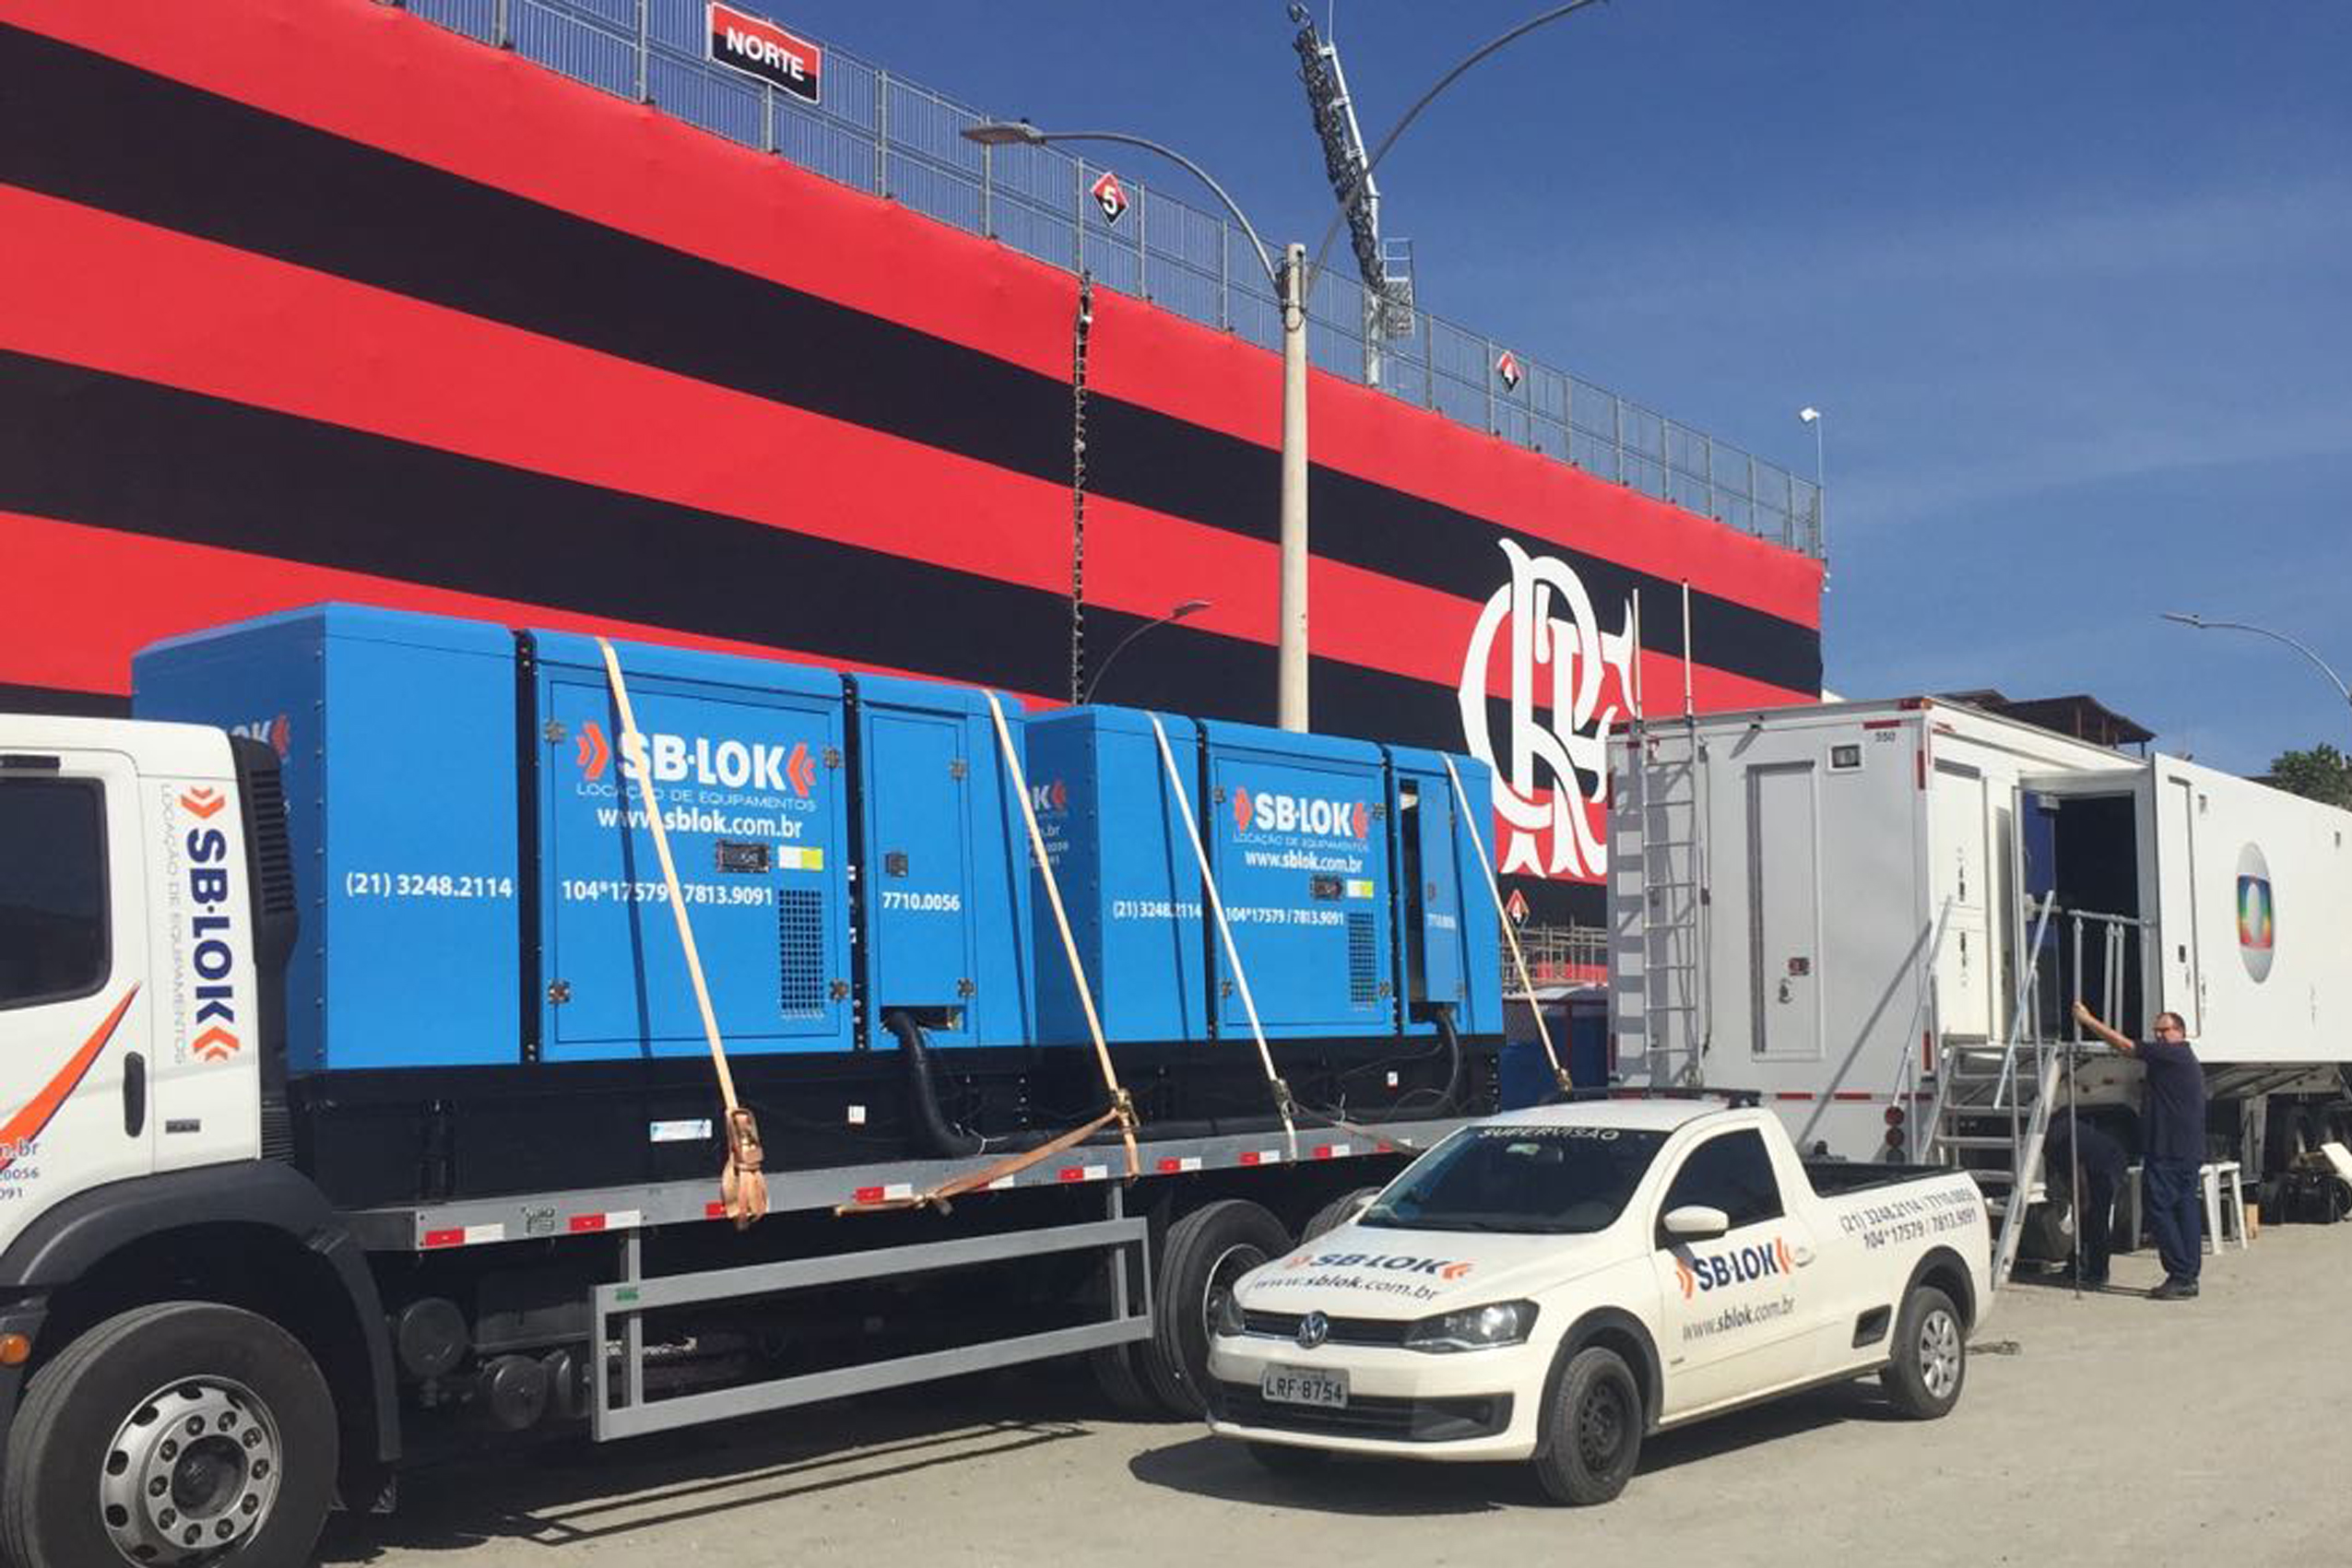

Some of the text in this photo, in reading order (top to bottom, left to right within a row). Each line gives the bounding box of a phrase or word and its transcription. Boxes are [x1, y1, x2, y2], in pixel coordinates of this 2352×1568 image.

[727, 26, 804, 81] NORTE
[1103, 184, 1117, 214] 5
[576, 782, 816, 812] LOCAÇO DE EQUIPAMENTOS
[597, 807, 803, 838] wwwsblok.com.br
[1246, 848, 1363, 873] www.sblok.com.br
[346, 871, 513, 898] (21) 3248.2114
[682, 884, 774, 906] 7813.9091
[882, 891, 962, 912] 7710.0056
[1113, 900, 1138, 920] (21)
[1512, 901, 1522, 924] 4
[1839, 1214, 1866, 1234] (21)
[1255, 1272, 1441, 1302] www.sblok.com.br
[1683, 1295, 1795, 1342] www.sblok.com.br
